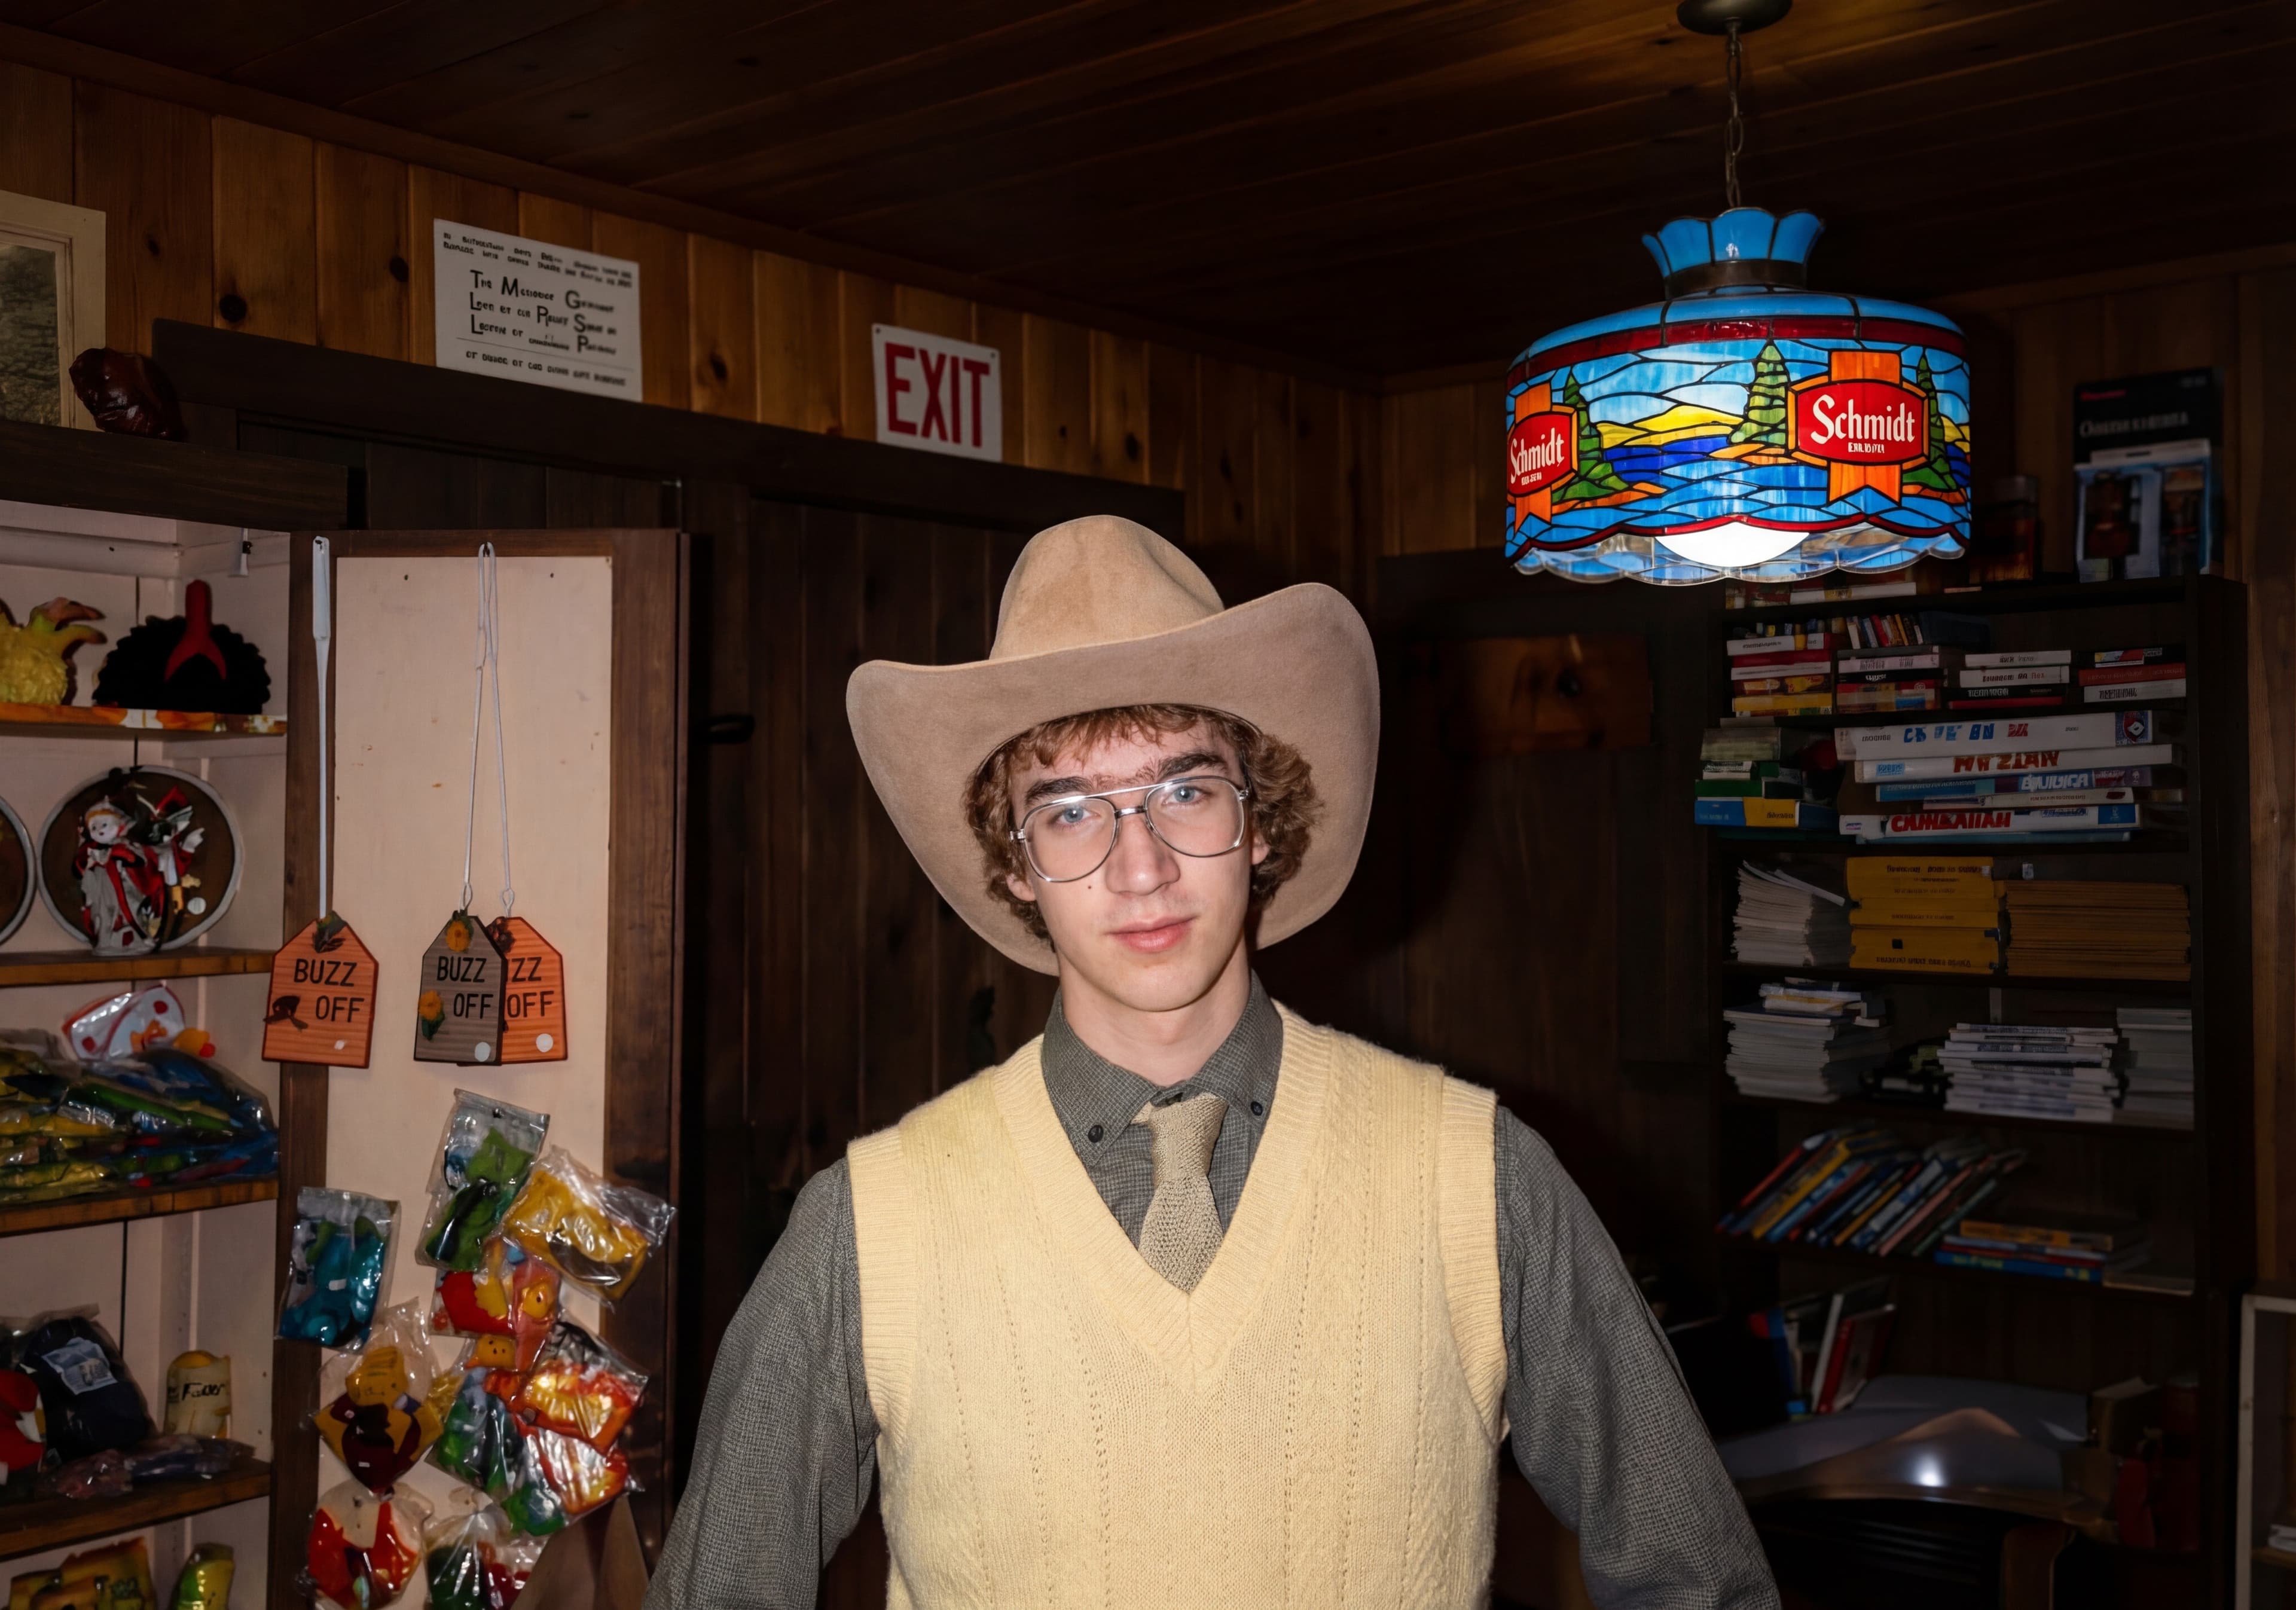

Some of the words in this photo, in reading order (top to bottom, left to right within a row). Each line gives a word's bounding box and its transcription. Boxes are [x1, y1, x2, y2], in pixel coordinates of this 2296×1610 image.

[884, 341, 990, 448] EXIT
[1810, 393, 1915, 445] Schmidt
[1510, 427, 1565, 484] Schmidt
[294, 958, 358, 986] BUZZ
[436, 956, 487, 983] BUZZ
[506, 957, 542, 982] ZZ
[315, 995, 365, 1022] OFF
[453, 992, 494, 1019] OFF
[506, 991, 554, 1018] OFF
